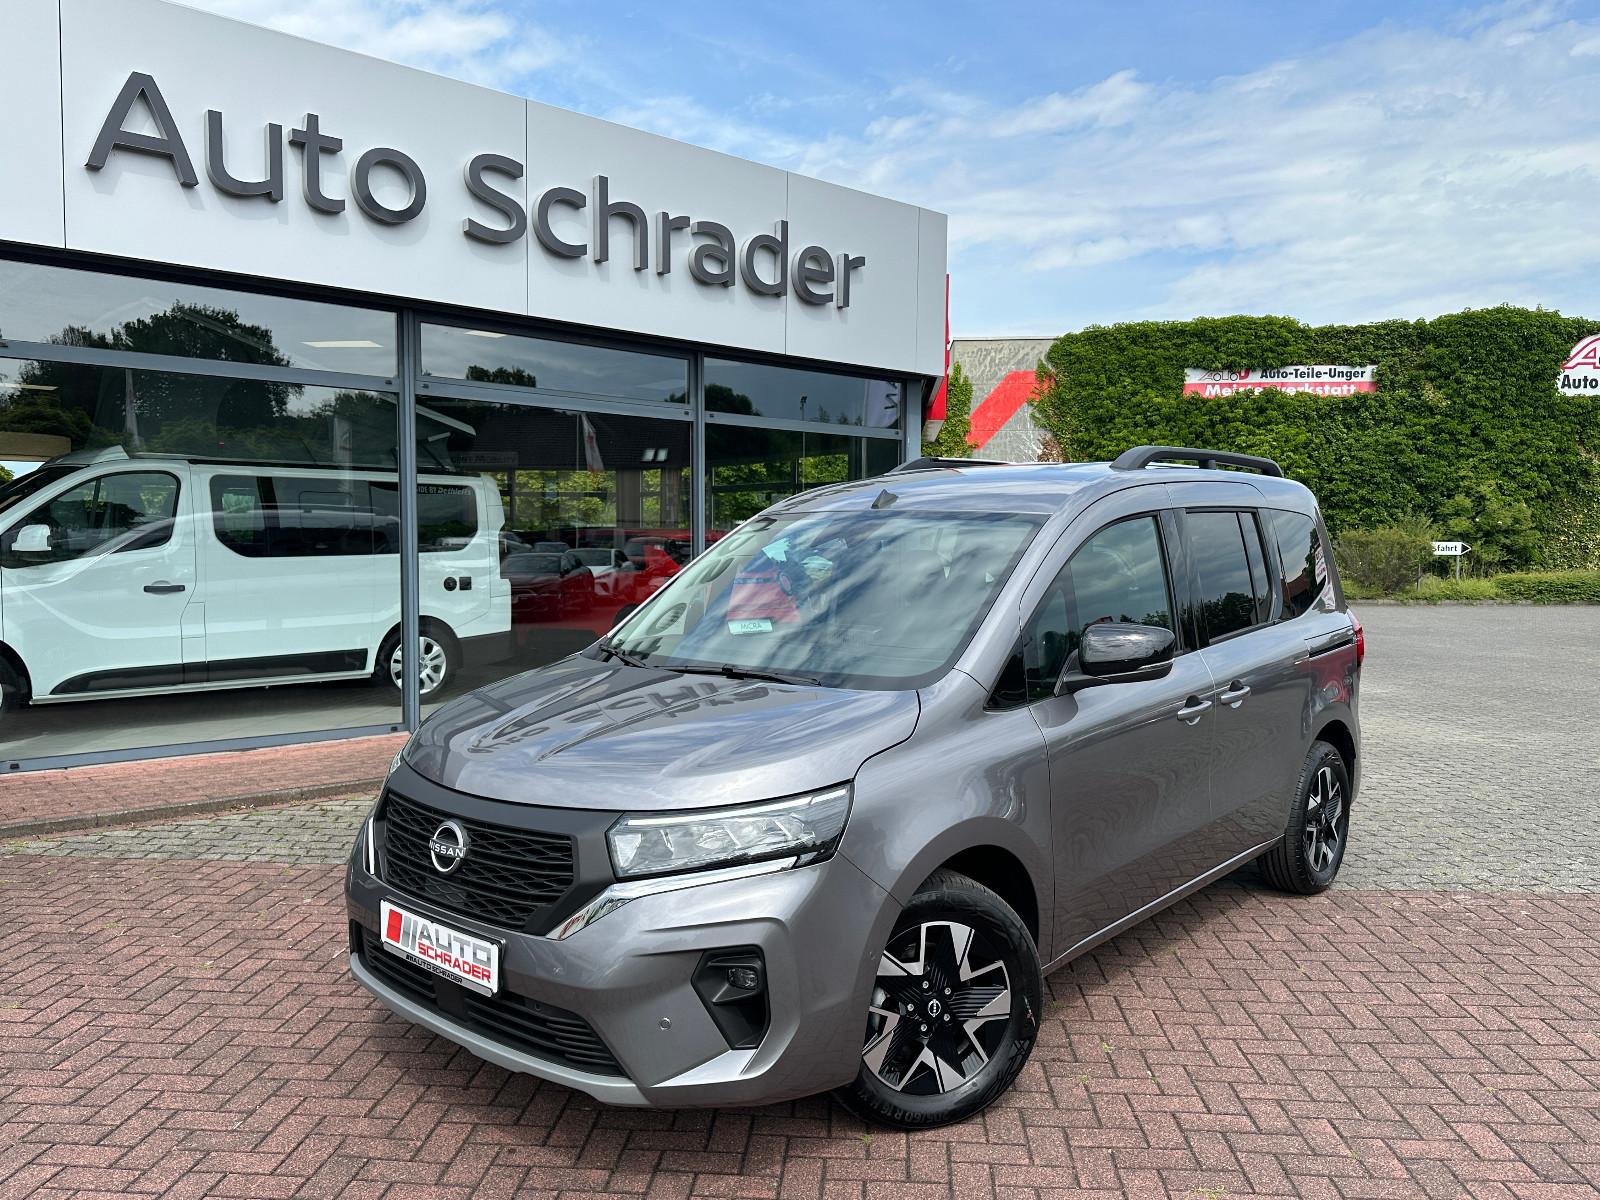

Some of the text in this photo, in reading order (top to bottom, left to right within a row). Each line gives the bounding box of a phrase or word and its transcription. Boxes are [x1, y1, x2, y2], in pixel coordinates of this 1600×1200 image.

[84, 70, 866, 310] Auto Schrader
[1259, 366, 1366, 381] Auto-Teile-Unger
[1560, 374, 1599, 390] Auto
[429, 839, 464, 858] NISSAN
[417, 922, 492, 969] AUTO
[417, 941, 492, 984] SCHRADER
